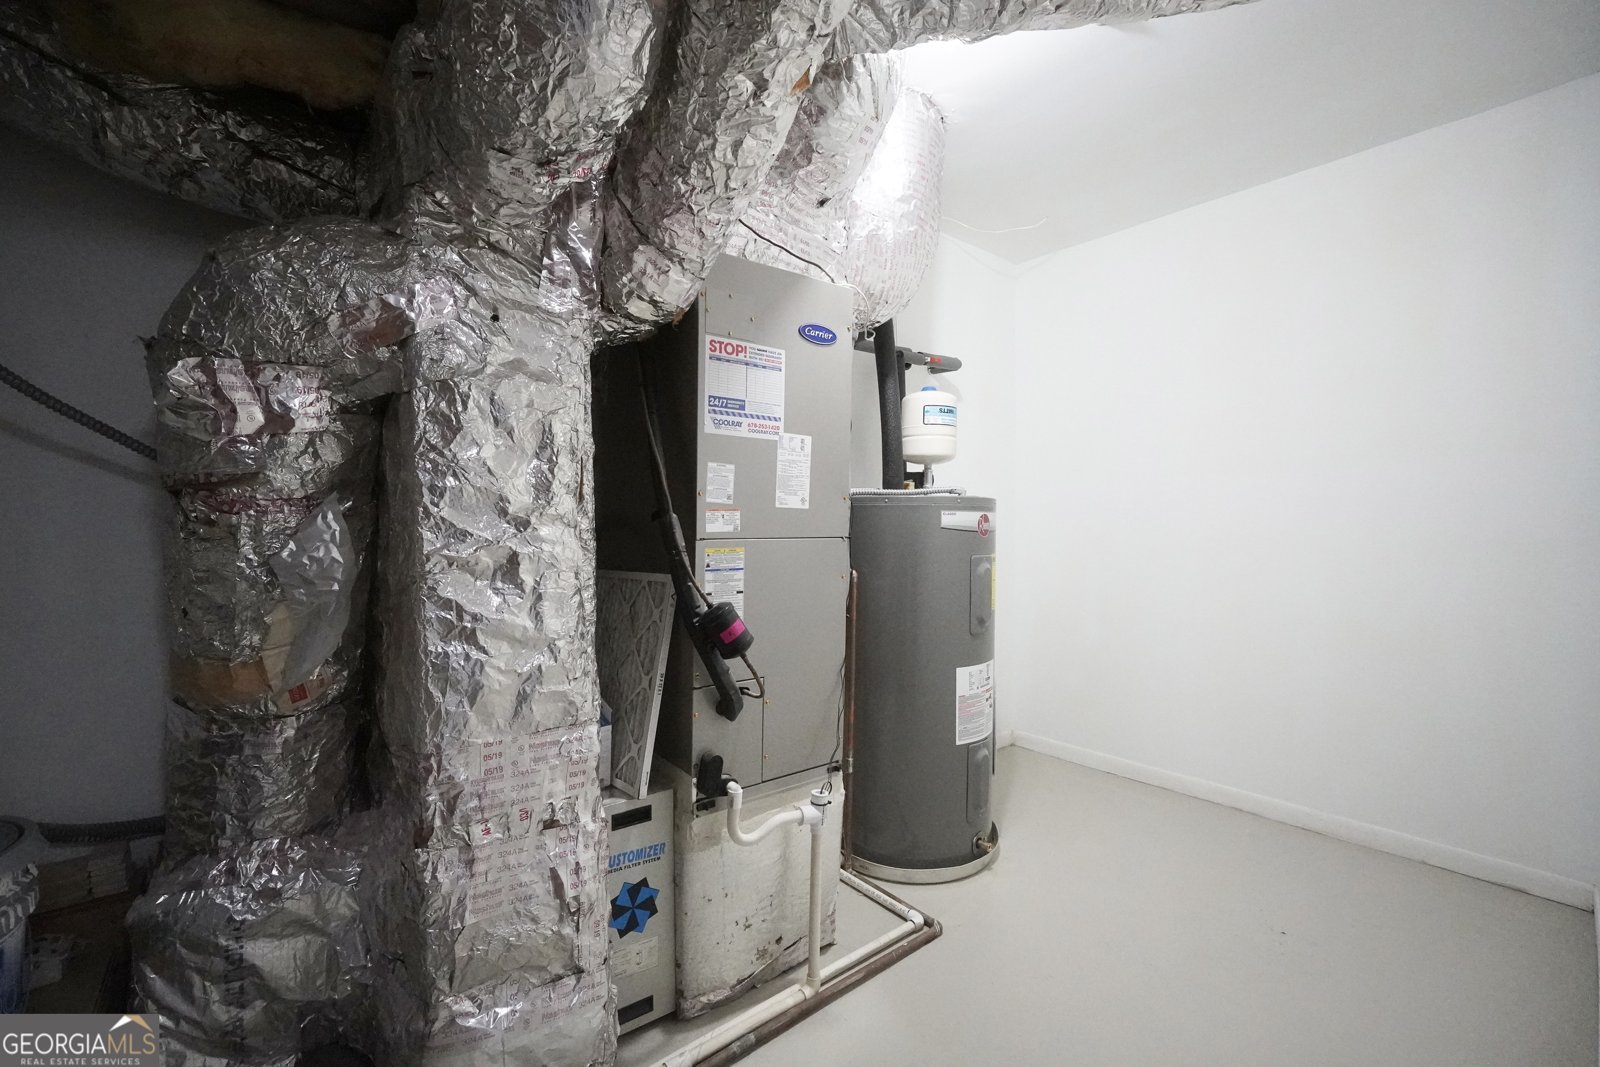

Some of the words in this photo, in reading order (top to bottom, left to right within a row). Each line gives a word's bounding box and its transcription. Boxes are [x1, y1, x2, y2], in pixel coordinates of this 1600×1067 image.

[804, 326, 833, 340] Carrier
[709, 339, 748, 358] STOP!
[709, 397, 727, 408] 24/7
[713, 418, 743, 428] COOLRAY
[483, 752, 503, 762] 05/19
[483, 766, 504, 777] 05/19
[569, 770, 587, 778] 05/19
[568, 781, 585, 791] 05/19
[608, 842, 667, 869] USTOMIZER
[623, 862, 641, 871] FILTER
[642, 856, 661, 866] SYSTEM
